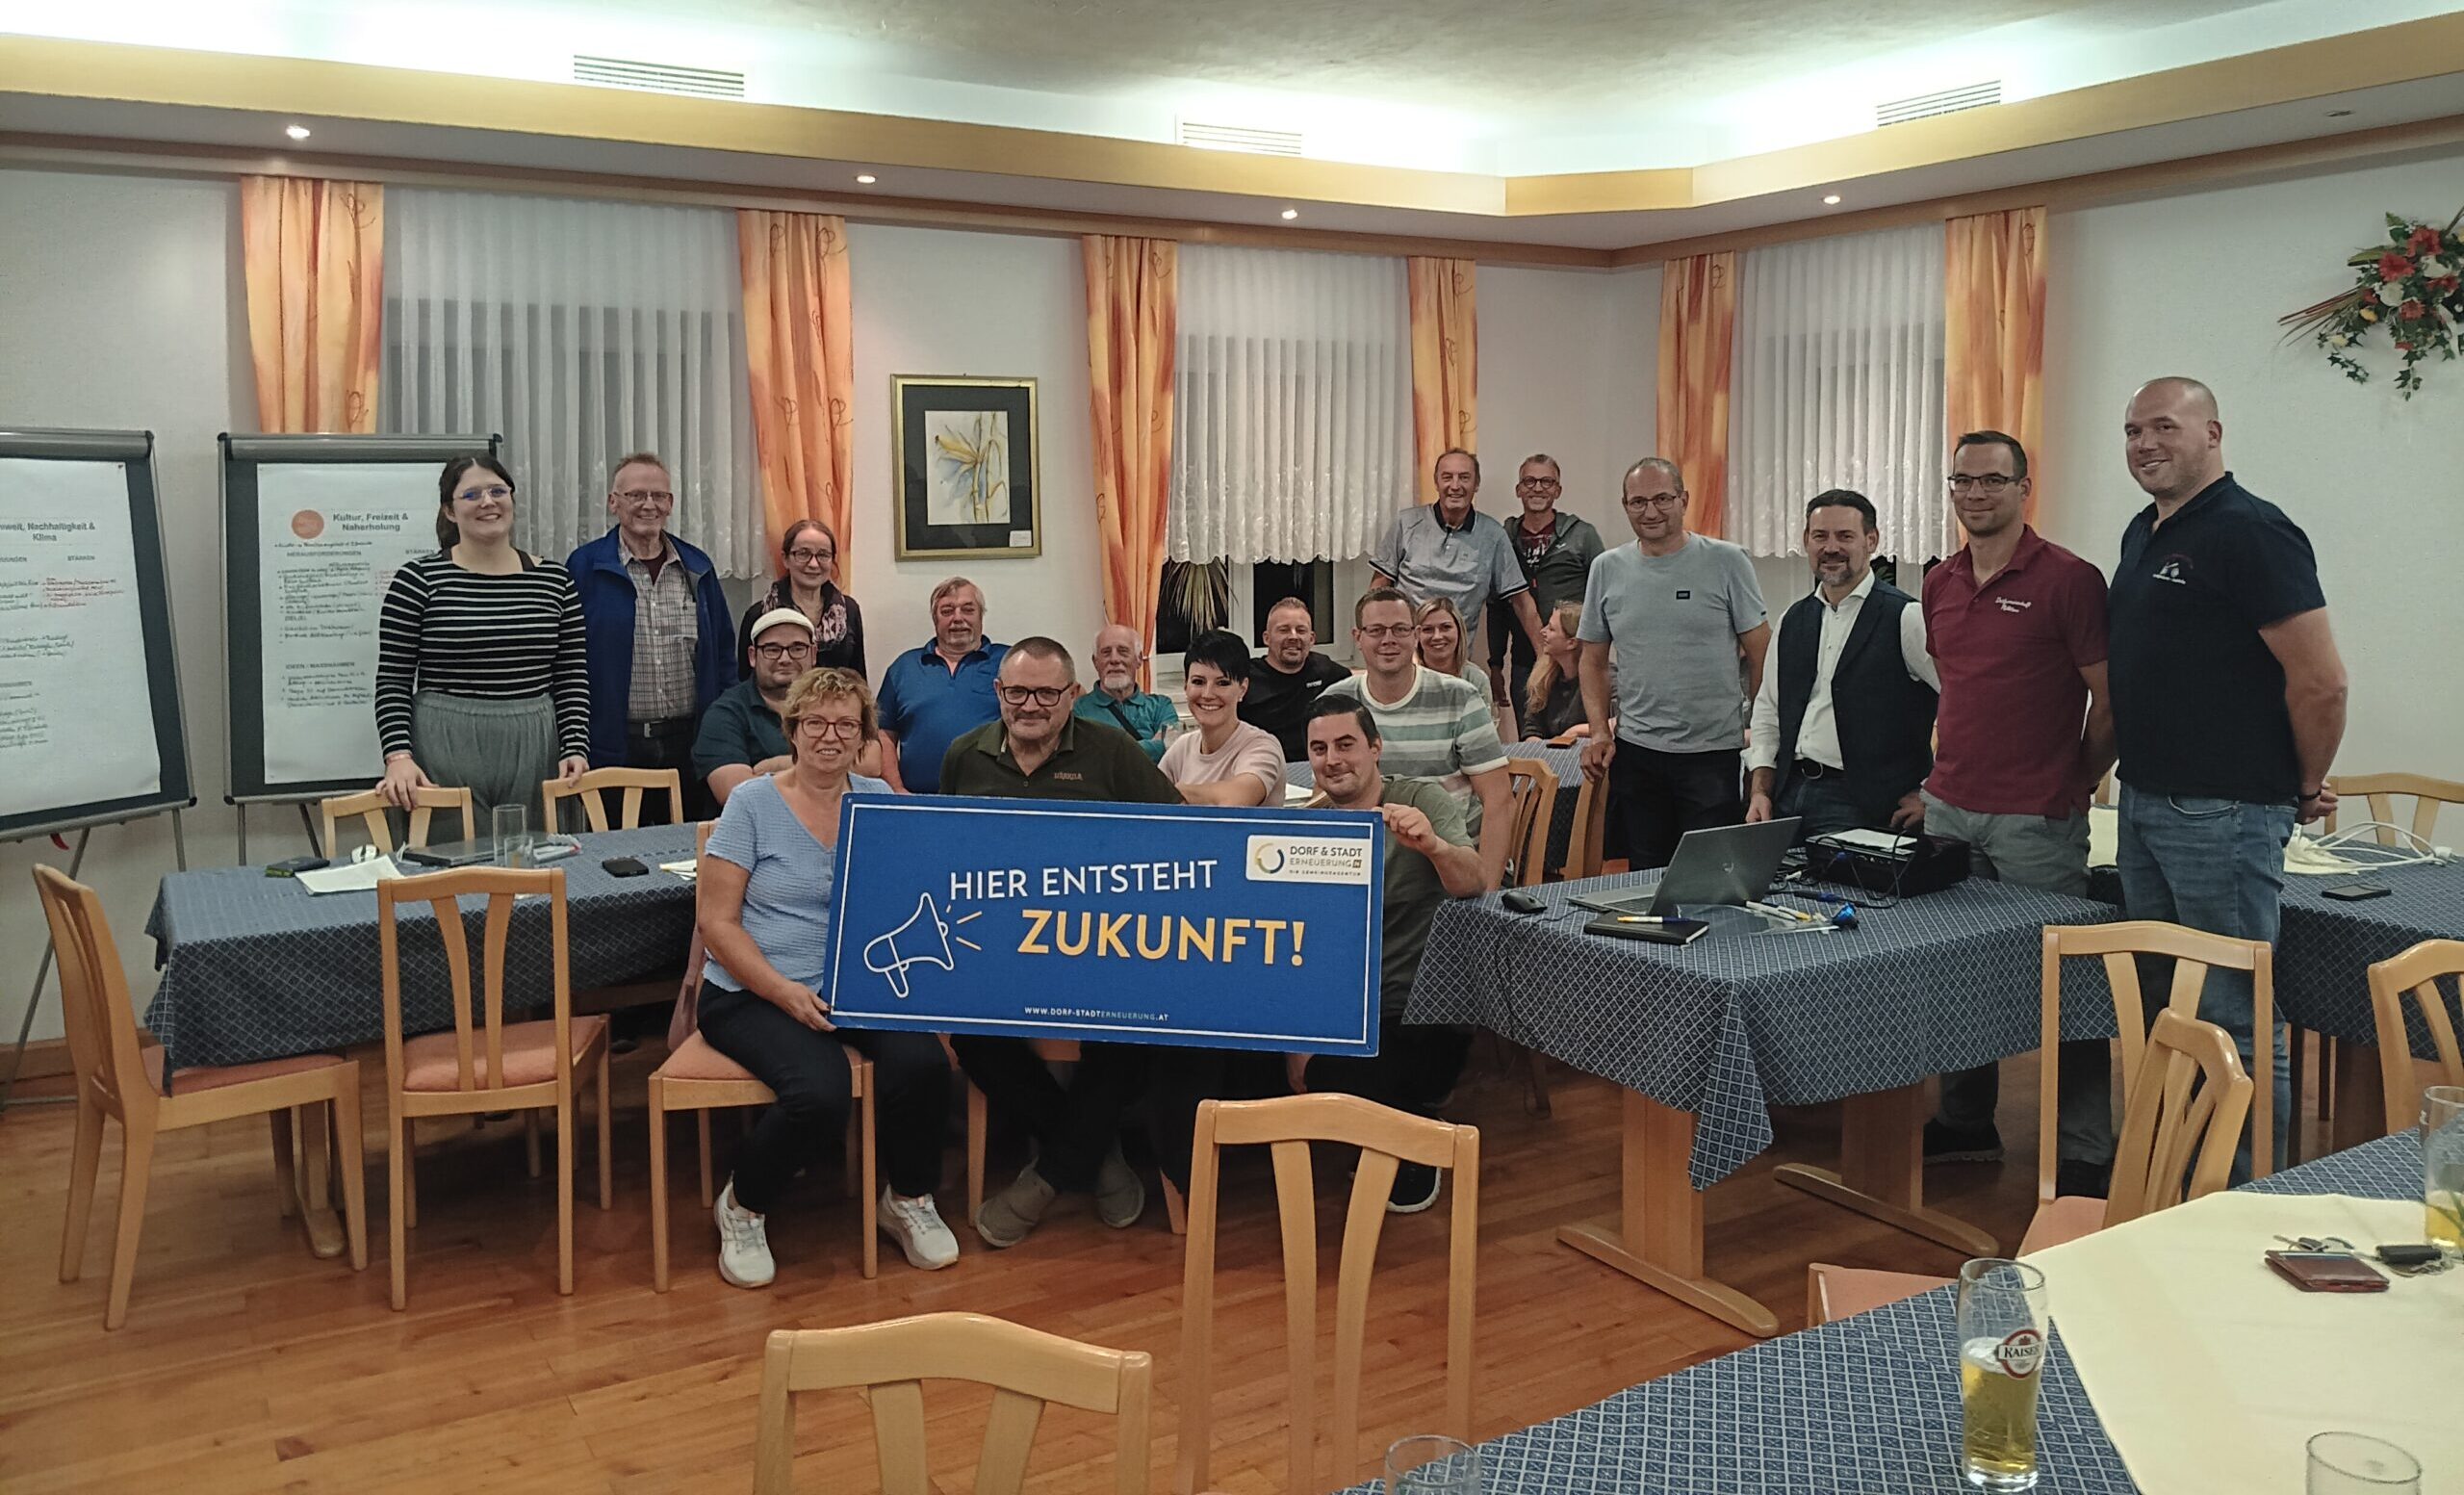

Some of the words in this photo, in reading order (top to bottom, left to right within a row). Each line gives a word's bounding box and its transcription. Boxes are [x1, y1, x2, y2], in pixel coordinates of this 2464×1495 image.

[332, 512, 365, 522] Kultur,
[366, 512, 399, 522] Freizeit
[401, 512, 409, 521] &
[89, 522, 95, 530] &
[342, 523, 400, 532] Naherholung
[1290, 845, 1319, 855] DORF
[1321, 846, 1328, 856] &
[1330, 847, 1362, 857] STADT
[1290, 858, 1351, 867] ERNEUERUNG
[949, 868, 1028, 901] HIER
[1041, 859, 1219, 896] ENTSTEHT
[1016, 909, 1305, 967] ZUKUNFT!
[1024, 1006, 1169, 1022] WWW.DORF-STADTERNEUERUNG.AT
